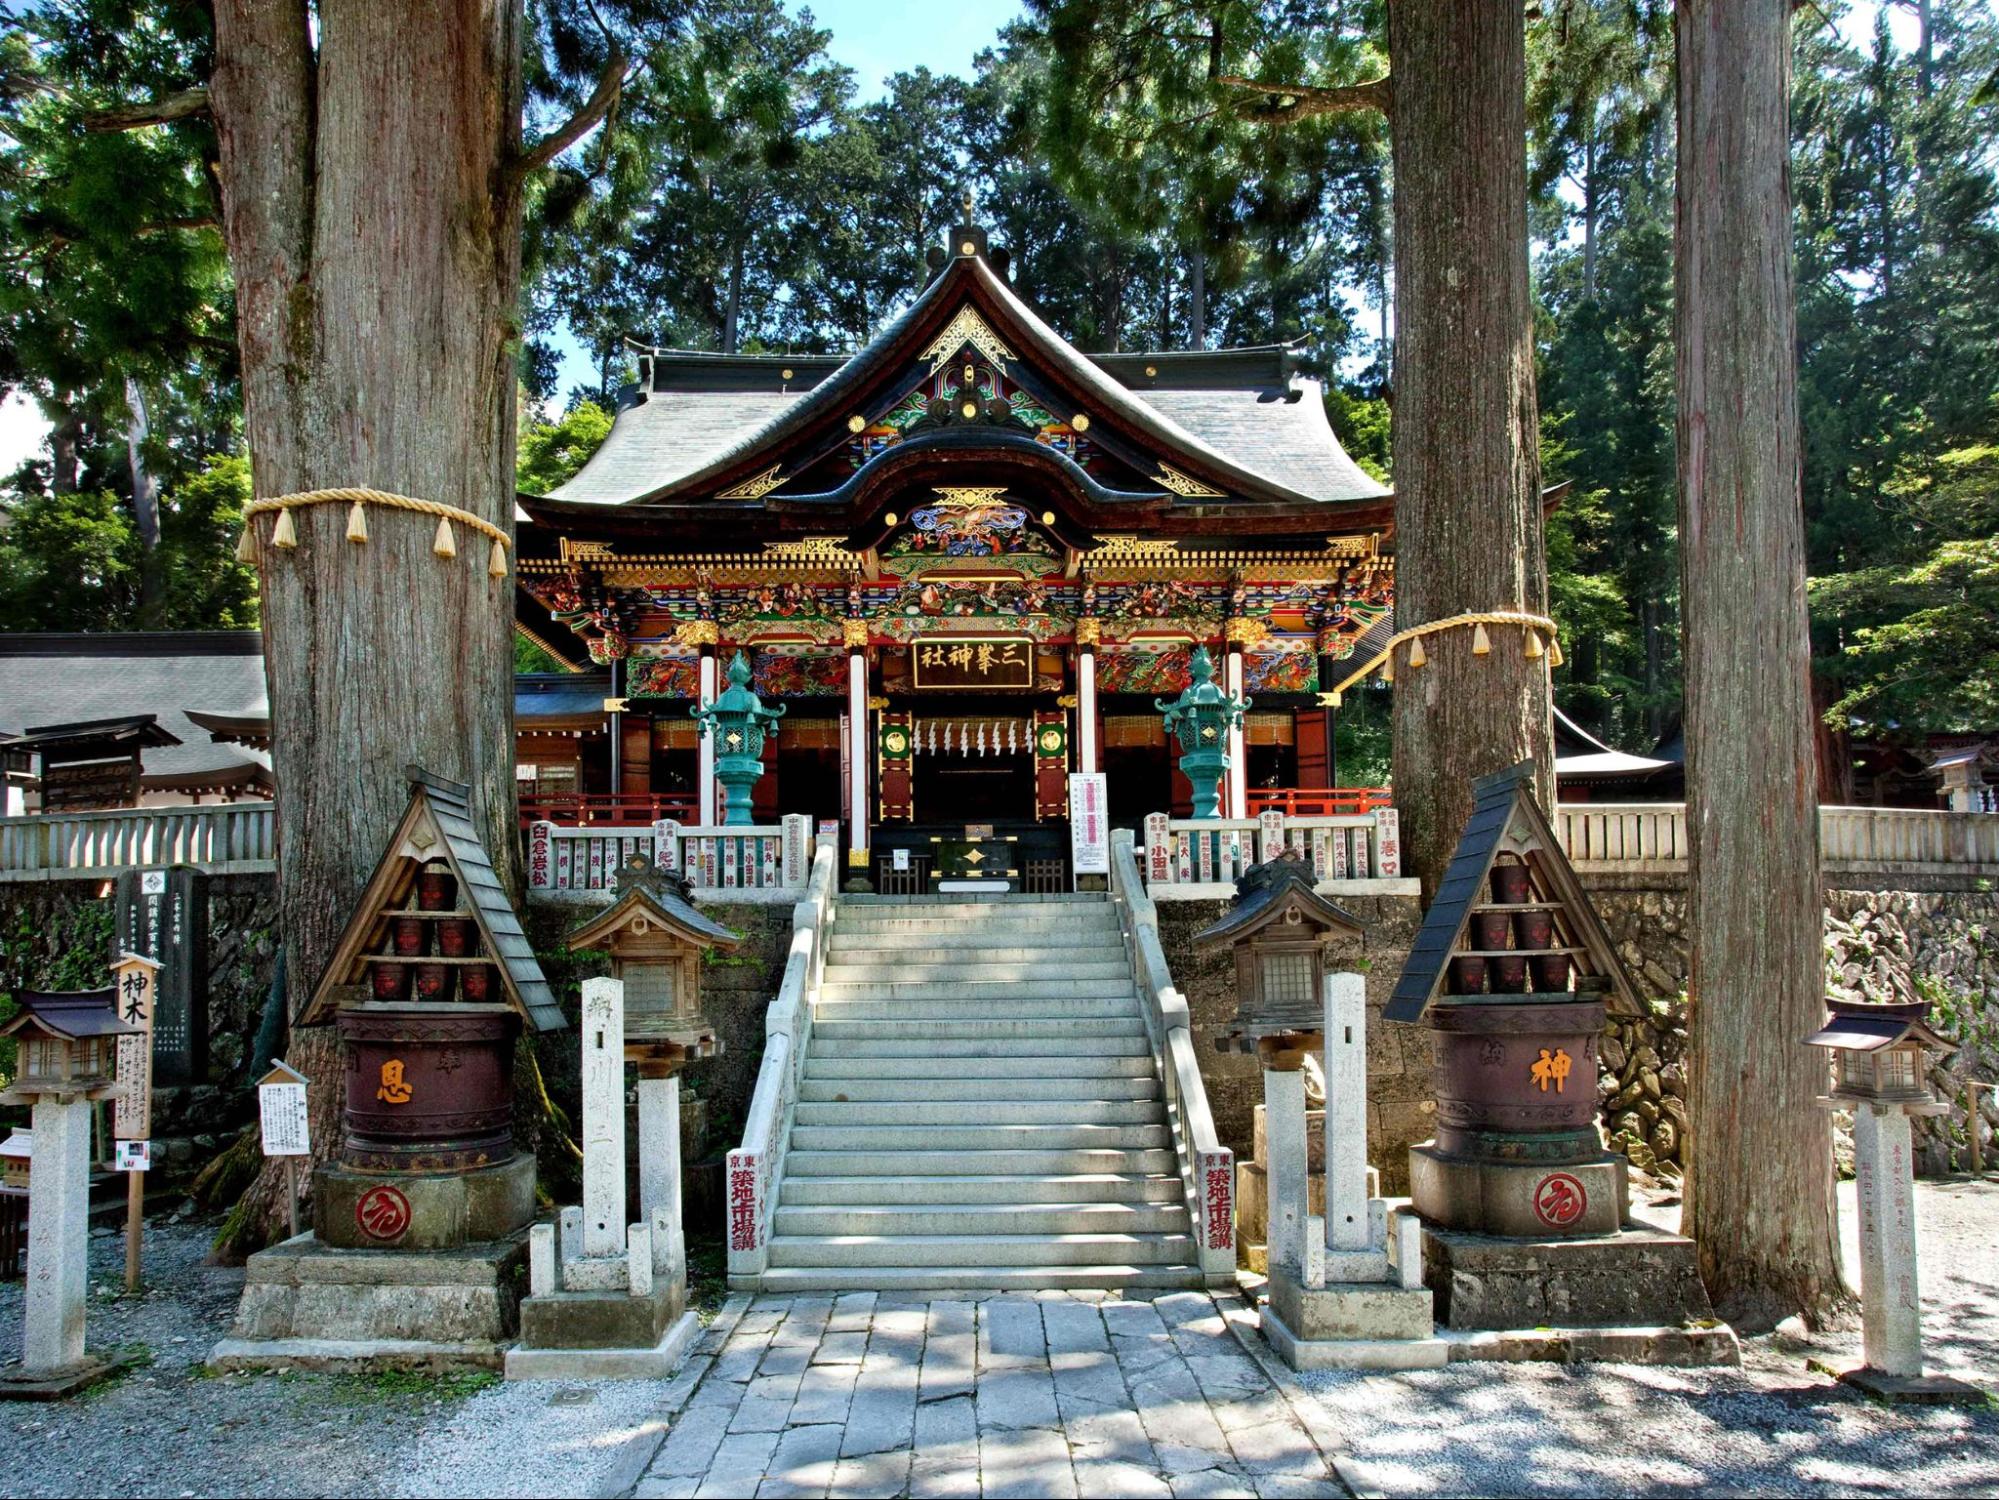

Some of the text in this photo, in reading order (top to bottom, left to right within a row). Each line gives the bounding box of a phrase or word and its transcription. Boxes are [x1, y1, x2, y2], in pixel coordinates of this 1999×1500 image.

[921, 642, 1026, 676] 三峯神社
[122, 971, 148, 1026] 神木
[1530, 1048, 1573, 1094] 神
[730, 1170, 757, 1252] 築地市場講
[1206, 1168, 1233, 1251] 築地市場講
